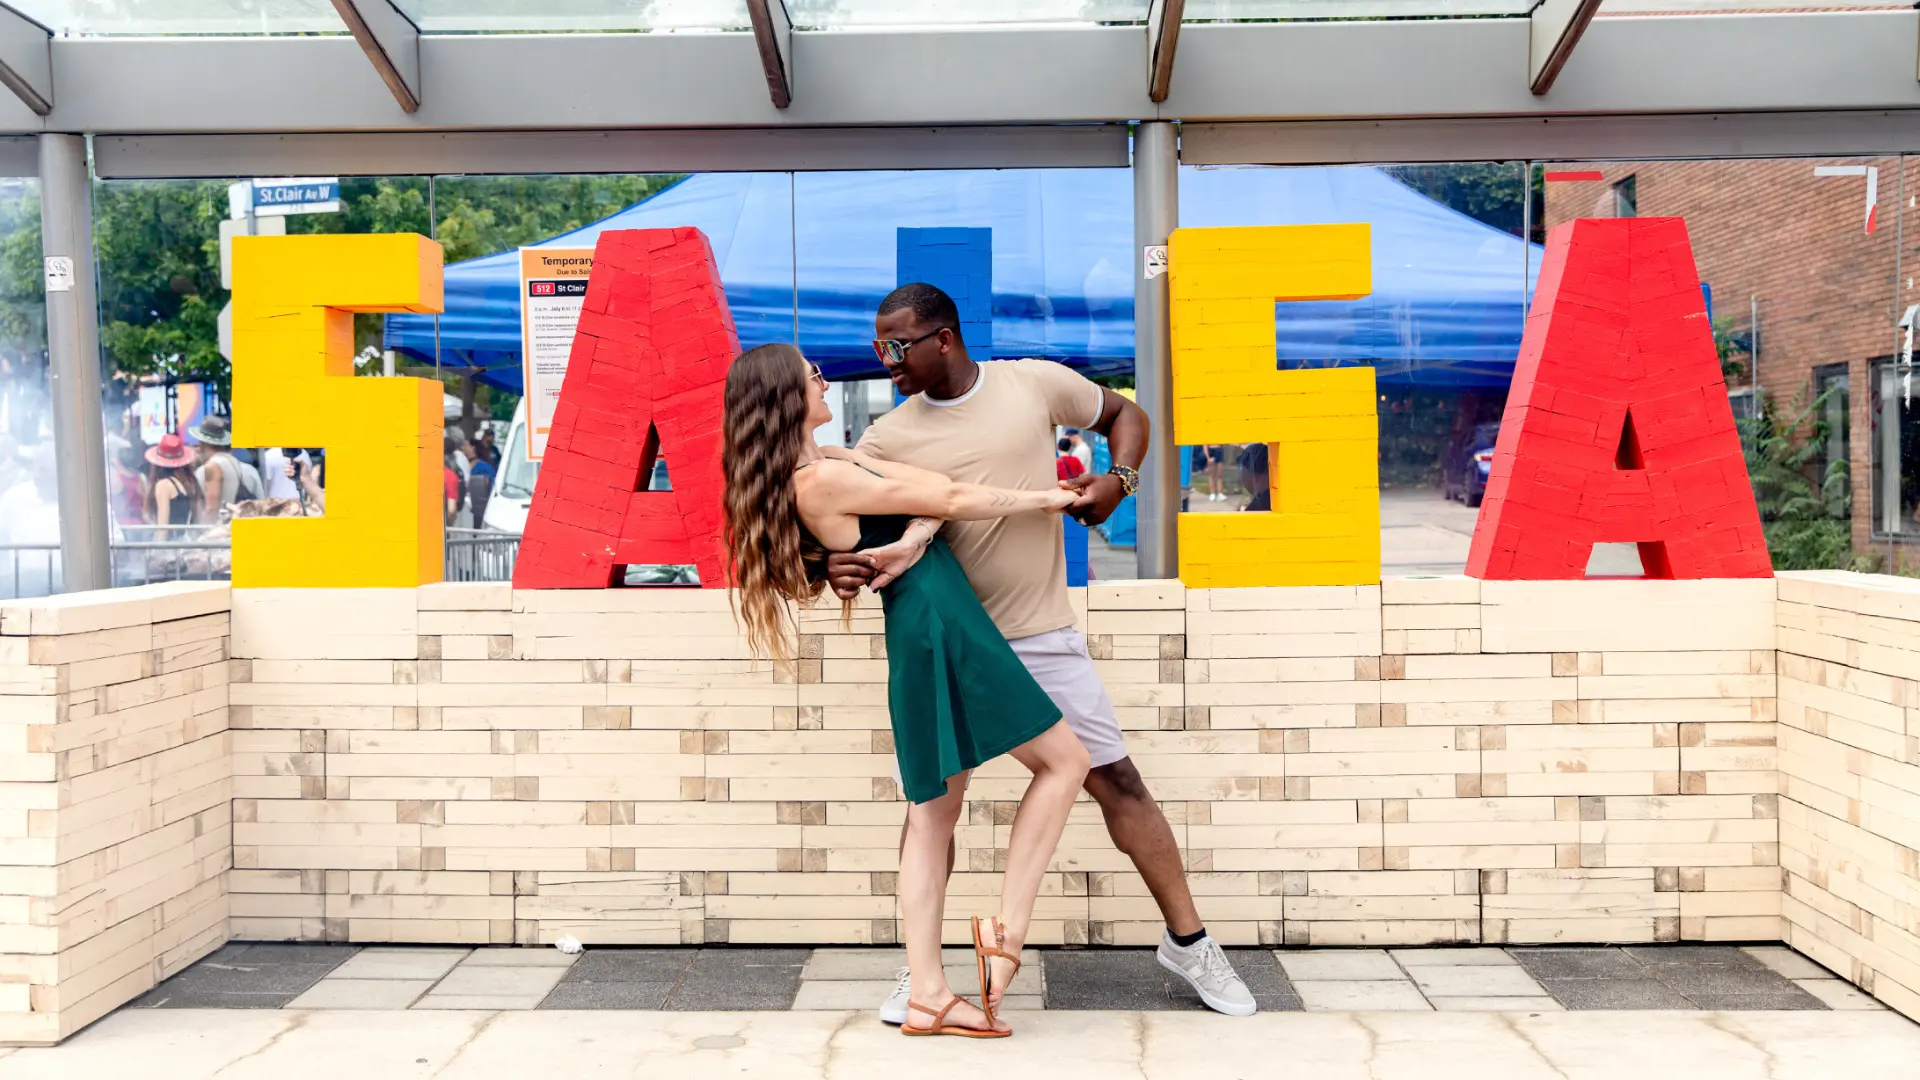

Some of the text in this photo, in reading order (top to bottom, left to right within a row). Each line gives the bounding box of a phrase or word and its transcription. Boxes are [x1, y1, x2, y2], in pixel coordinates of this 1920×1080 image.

[304, 190, 317, 200] Av
[318, 185, 330, 199] W
[541, 256, 594, 267] Temporary
[536, 285, 551, 293] 512
[567, 284, 586, 292] Clair
